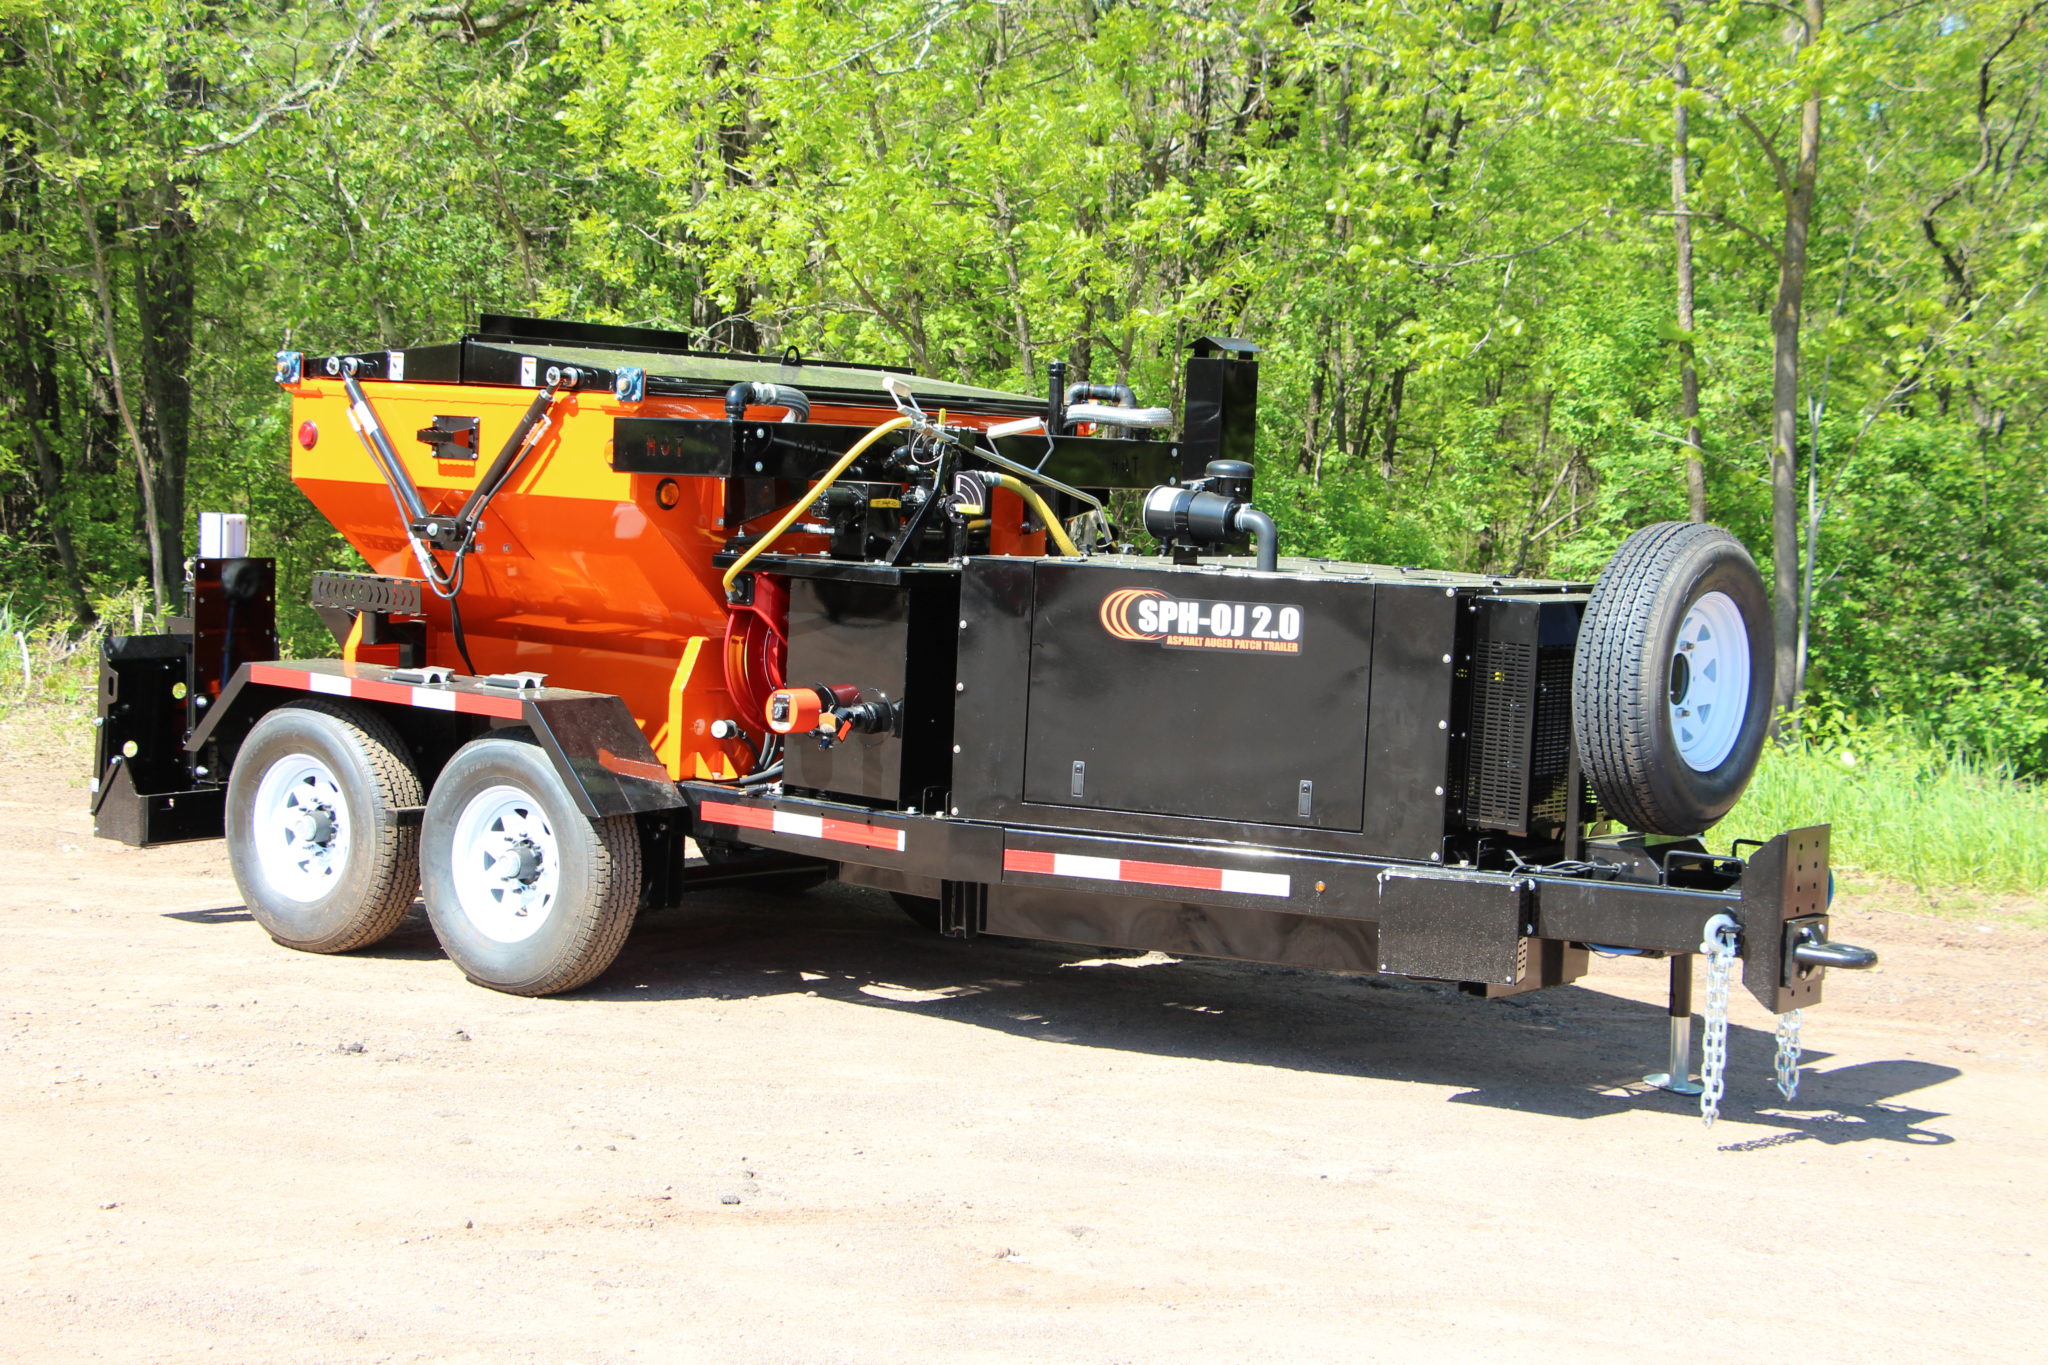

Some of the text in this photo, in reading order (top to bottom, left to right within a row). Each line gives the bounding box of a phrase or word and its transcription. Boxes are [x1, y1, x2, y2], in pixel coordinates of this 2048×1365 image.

[1138, 599, 1300, 641] SPH-OJ 2.0
[1166, 635, 1299, 653] ASPHALT AUGER PATCH TRAILER
